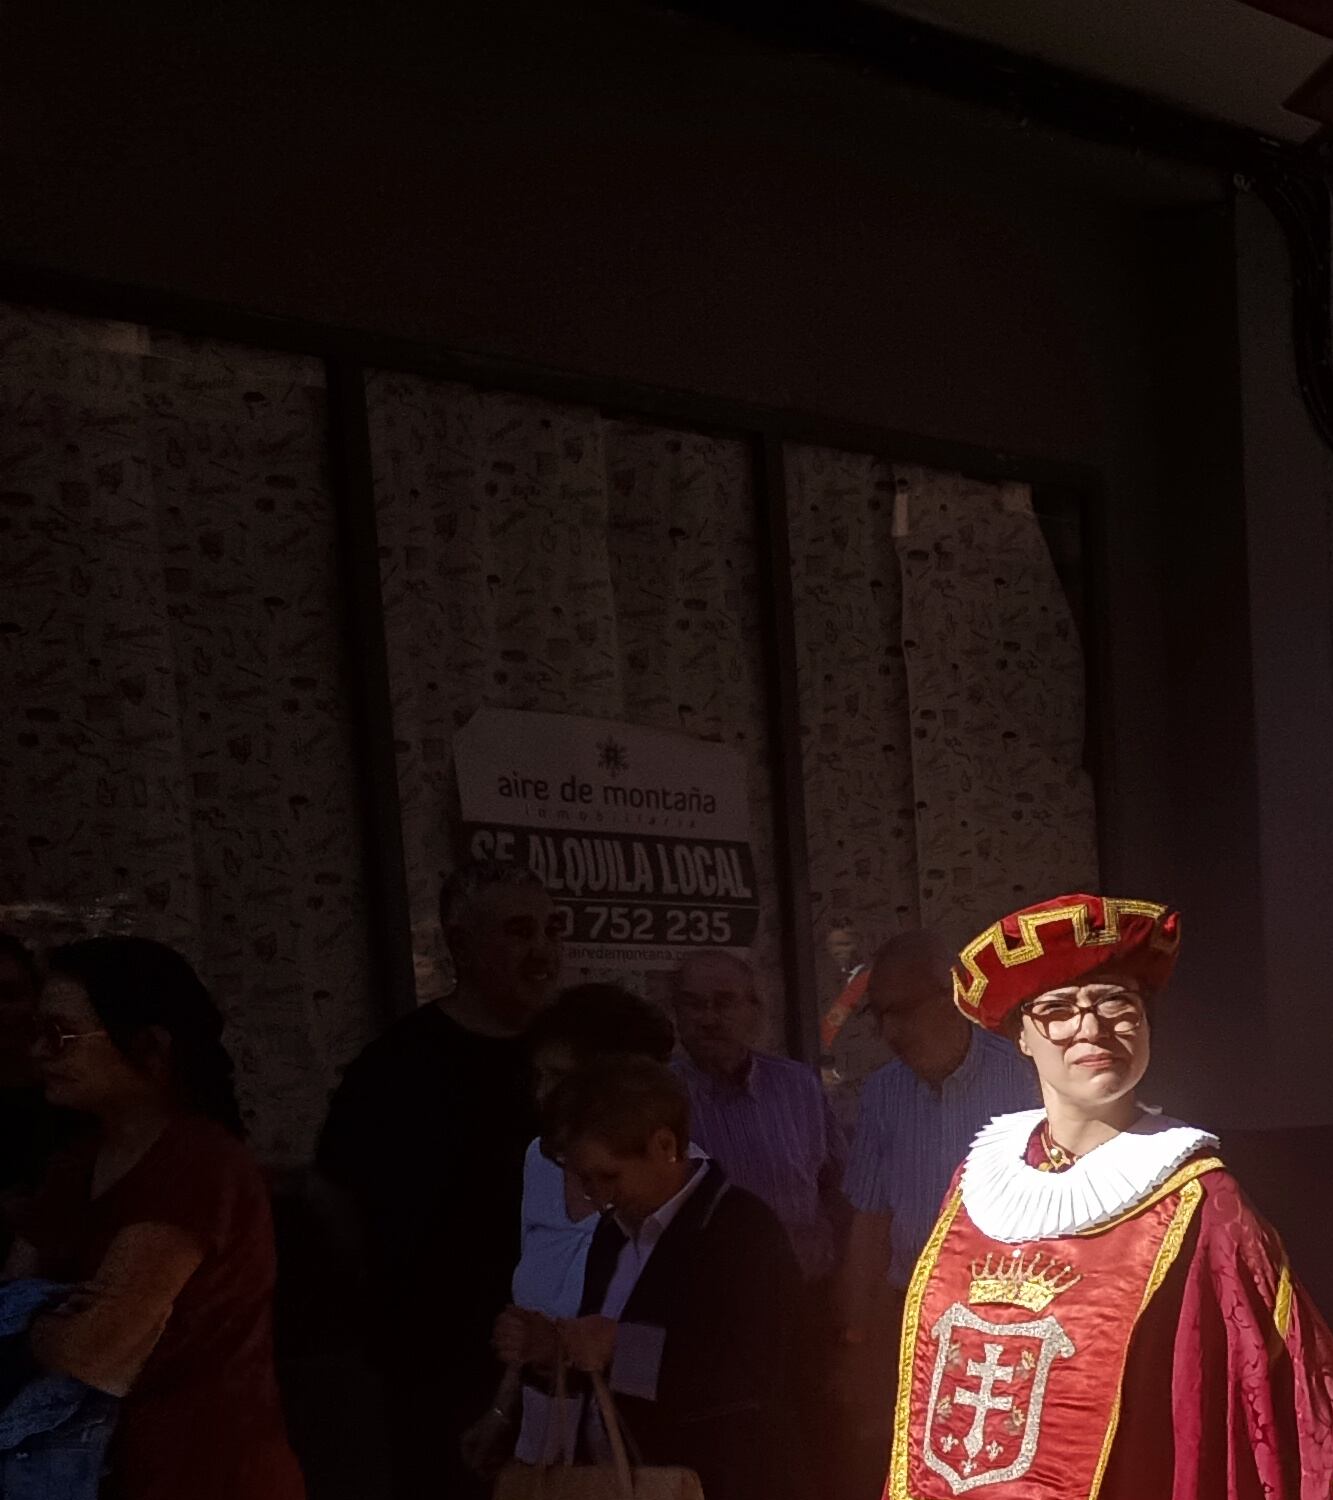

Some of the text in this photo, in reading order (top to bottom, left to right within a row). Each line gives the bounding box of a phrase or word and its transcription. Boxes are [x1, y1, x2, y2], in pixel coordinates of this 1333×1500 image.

[498, 772, 717, 814] aire de montaña
[527, 832, 655, 896] ALQUILA
[657, 842, 753, 899] LOCAL
[583, 906, 656, 942] 752
[665, 909, 733, 944] 235
